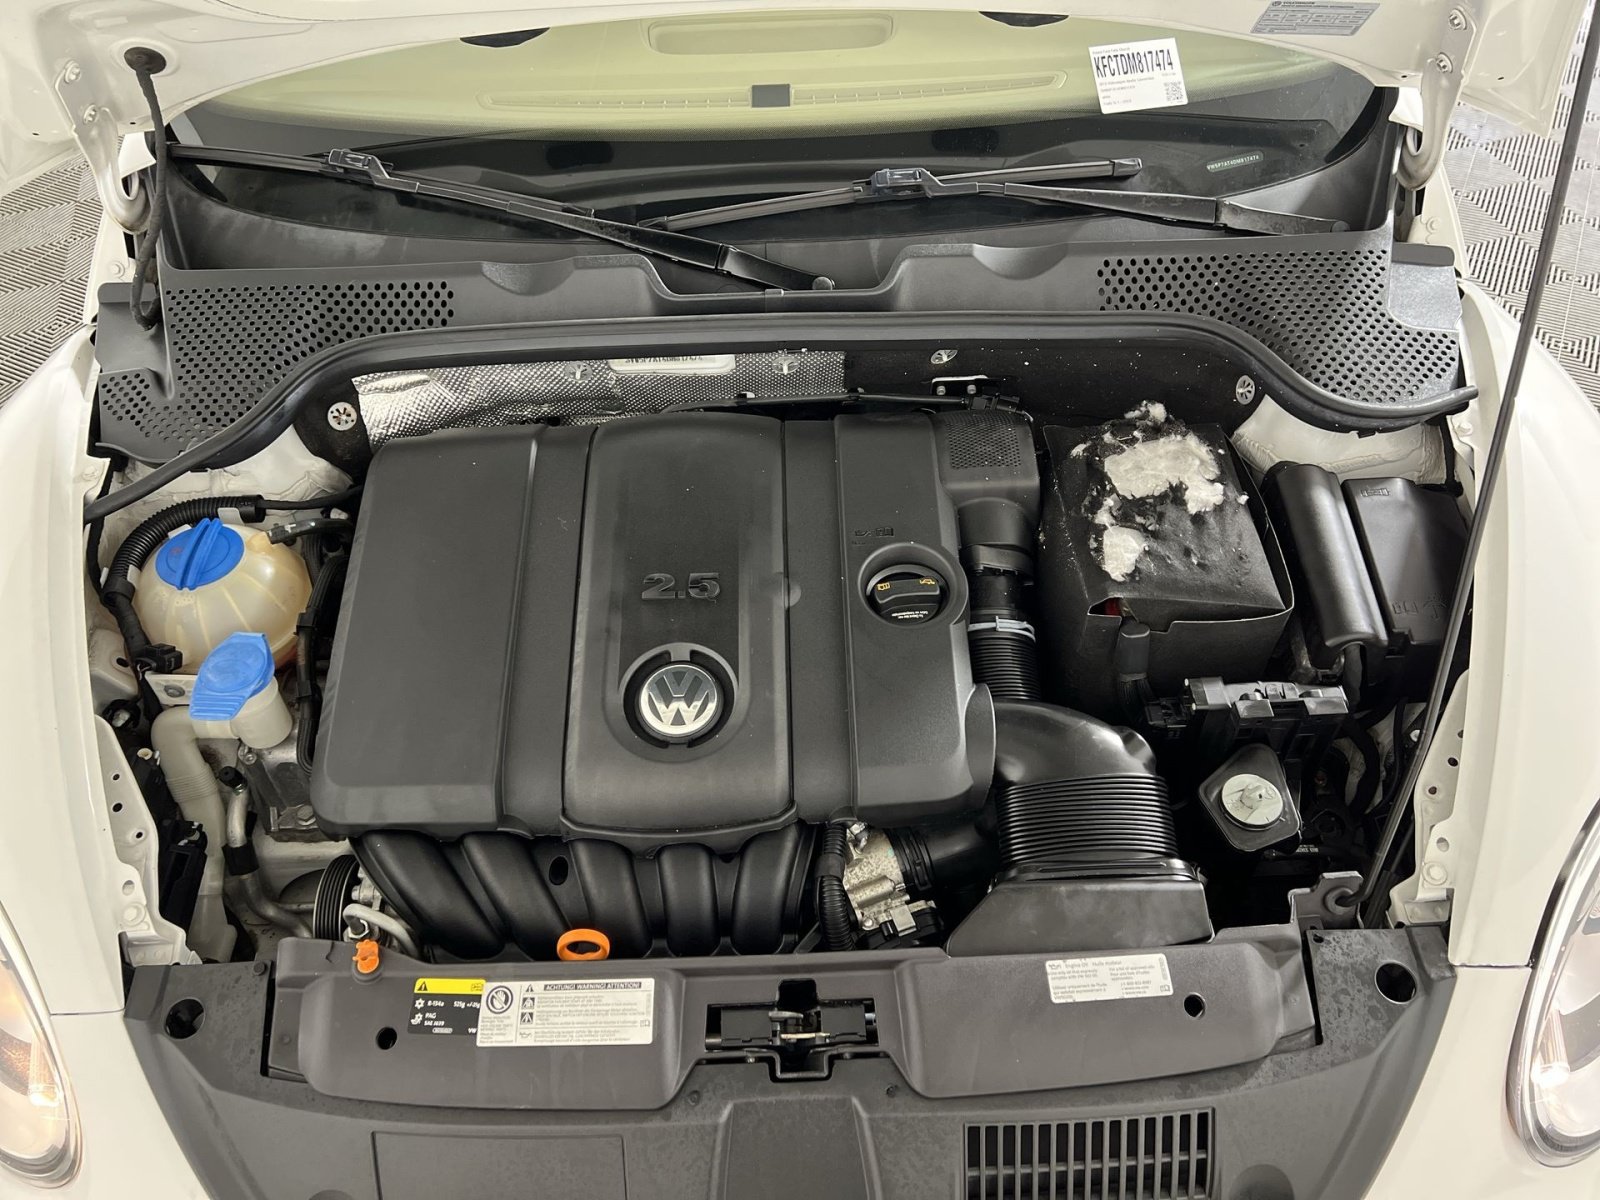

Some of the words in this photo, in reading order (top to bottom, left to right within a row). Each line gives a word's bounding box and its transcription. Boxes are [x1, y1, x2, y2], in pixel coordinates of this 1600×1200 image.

[1094, 48, 1174, 79] KFCTDM817474
[641, 572, 721, 600] 2.5
[546, 983, 576, 991] ACHTUNG!
[577, 982, 606, 991] WARNING!
[606, 981, 641, 990] ATTENTION!
